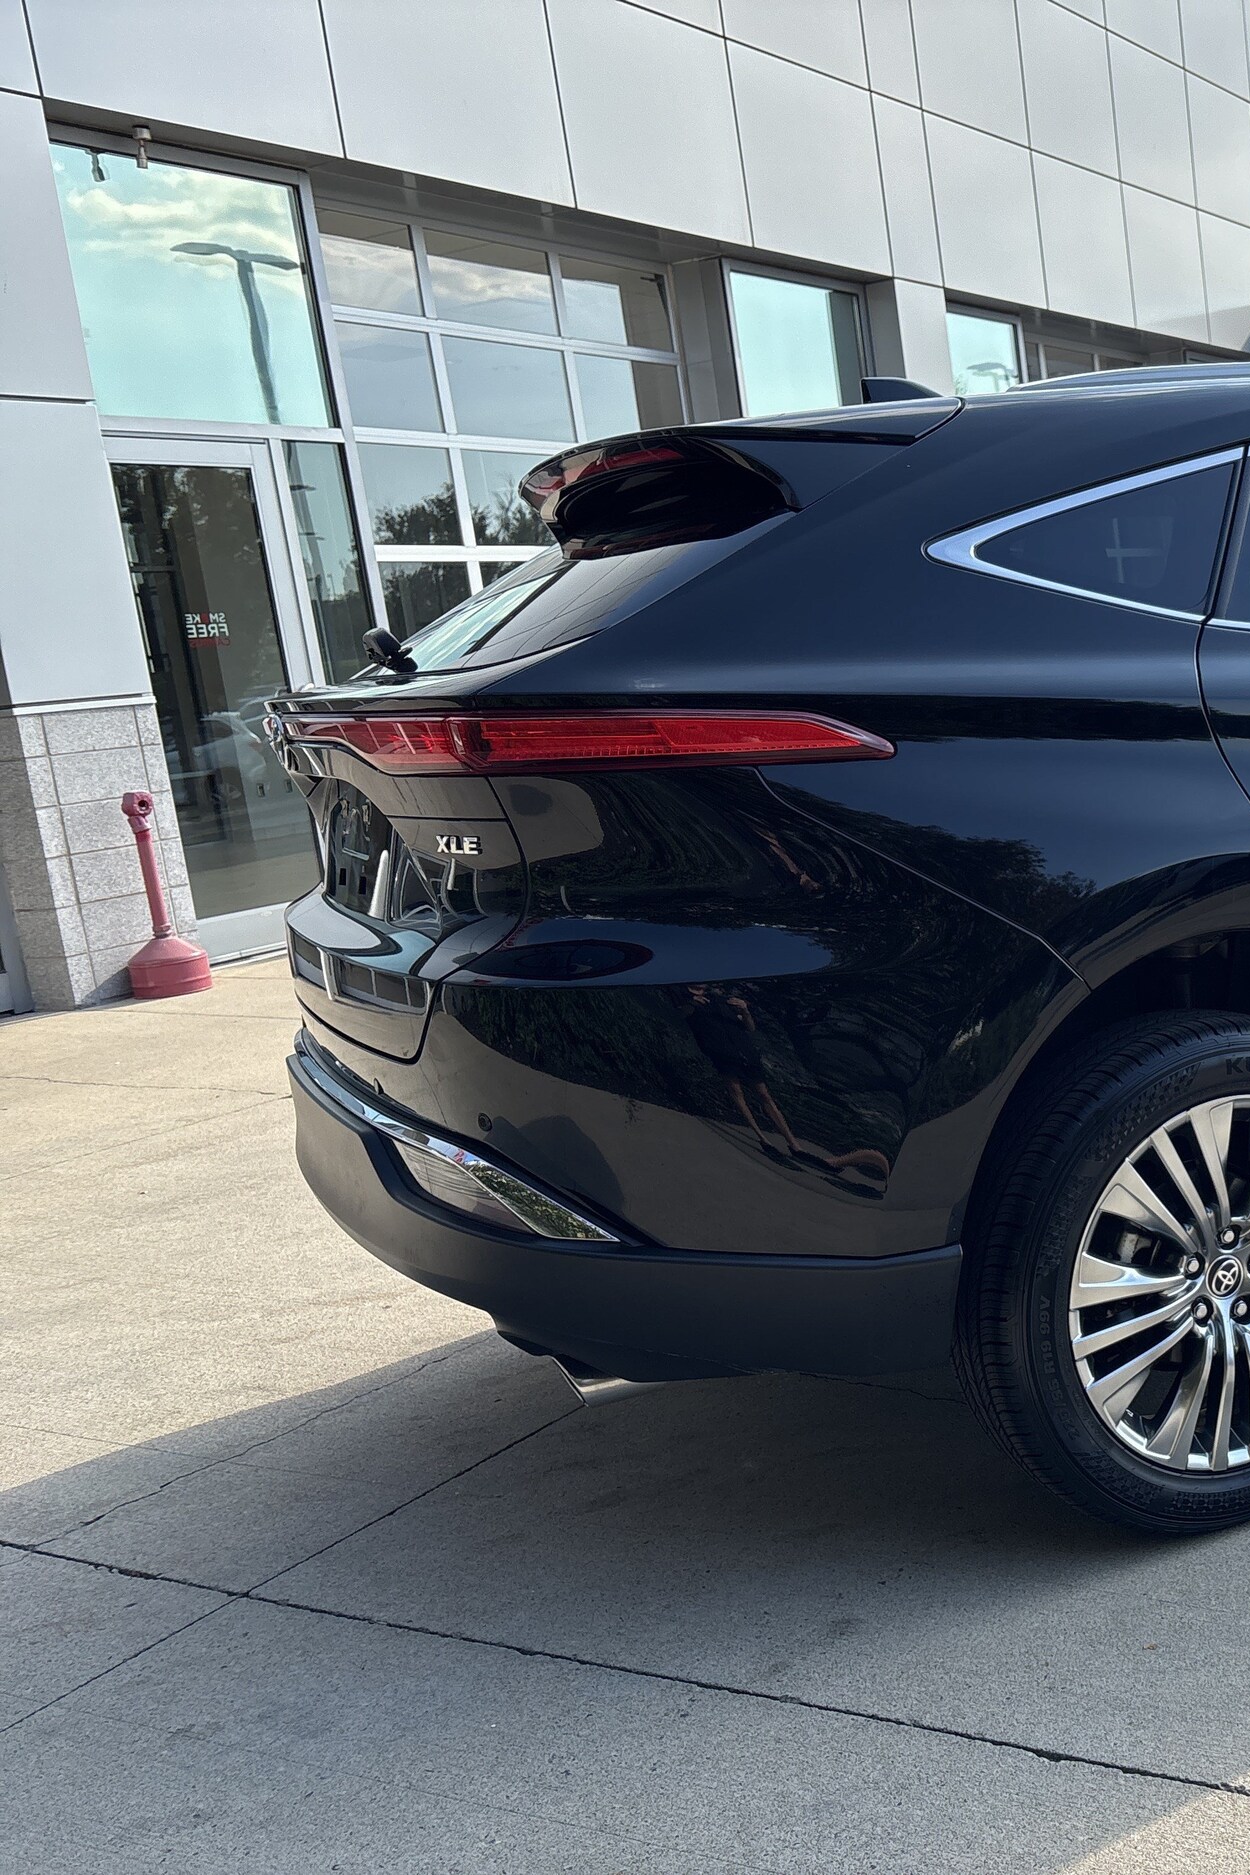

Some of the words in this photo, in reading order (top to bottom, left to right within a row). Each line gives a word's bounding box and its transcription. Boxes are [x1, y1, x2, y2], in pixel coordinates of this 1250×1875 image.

[435, 835, 480, 855] XLE
[1038, 1295, 1051, 1335] 99V
[1040, 1340, 1056, 1375] R19
